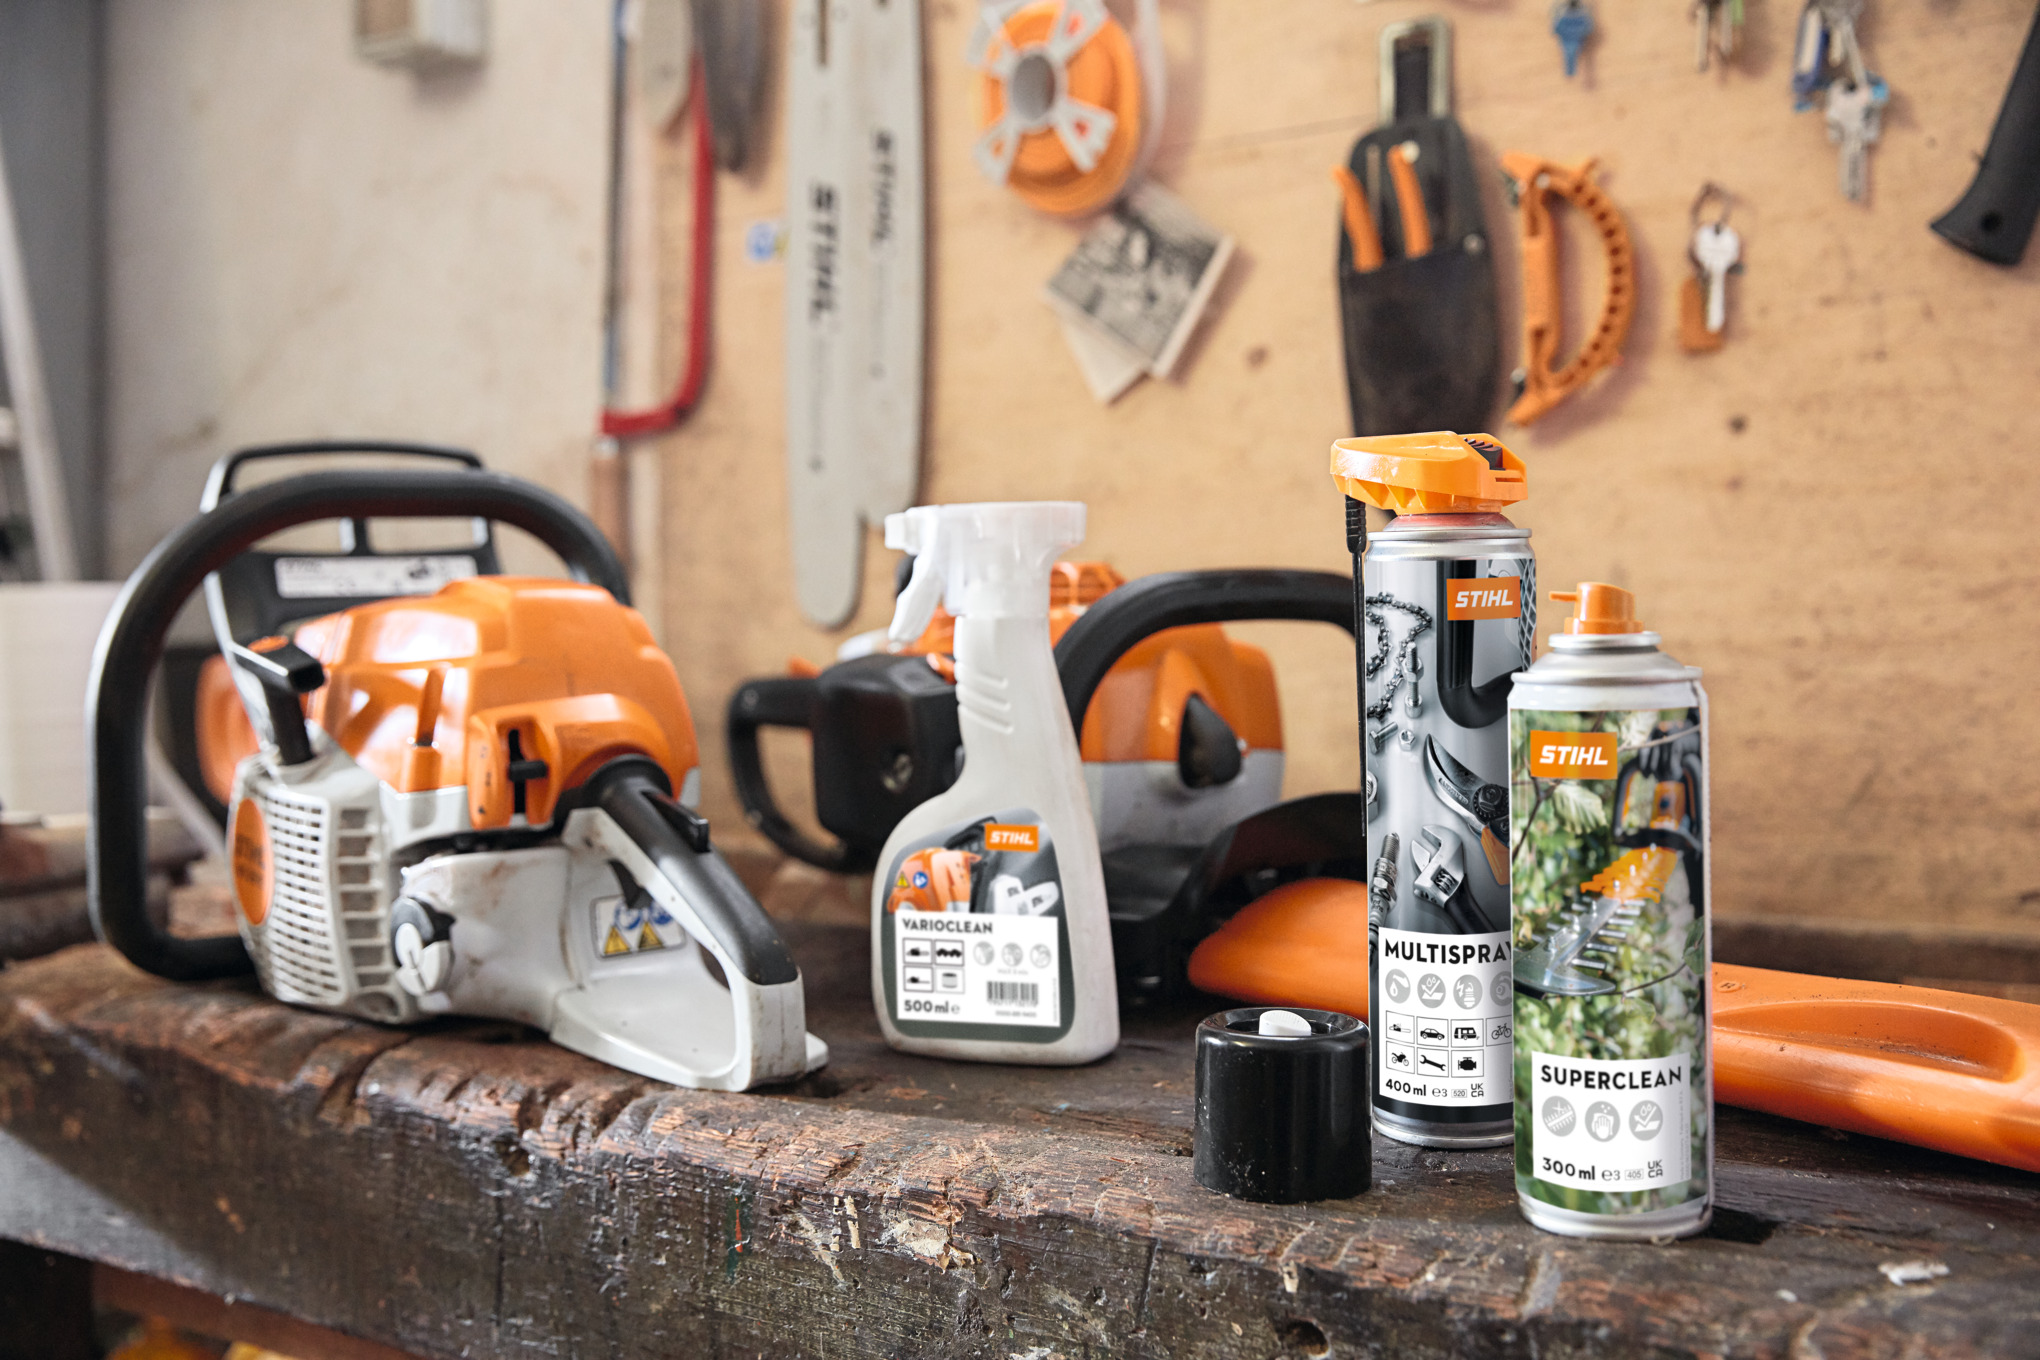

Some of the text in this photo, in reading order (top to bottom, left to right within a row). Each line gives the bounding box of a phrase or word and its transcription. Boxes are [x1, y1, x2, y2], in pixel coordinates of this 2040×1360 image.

[1455, 590, 1514, 607] STIHL
[1540, 745, 1608, 766] STIHL
[990, 830, 1034, 846] STIHL
[902, 918, 993, 934] VARIOCLEAN
[904, 999, 933, 1013] 500
[934, 1000, 949, 1014] ml
[1541, 1065, 1682, 1090] SUPERCLEAN
[1386, 1078, 1411, 1093] 400
[1413, 1085, 1426, 1097] ml
[1471, 1090, 1485, 1098] CA
[1543, 1157, 1576, 1177] 300
[1578, 1165, 1596, 1181] ml
[1647, 1160, 1663, 1170] UK
[1648, 1169, 1663, 1179] CA
